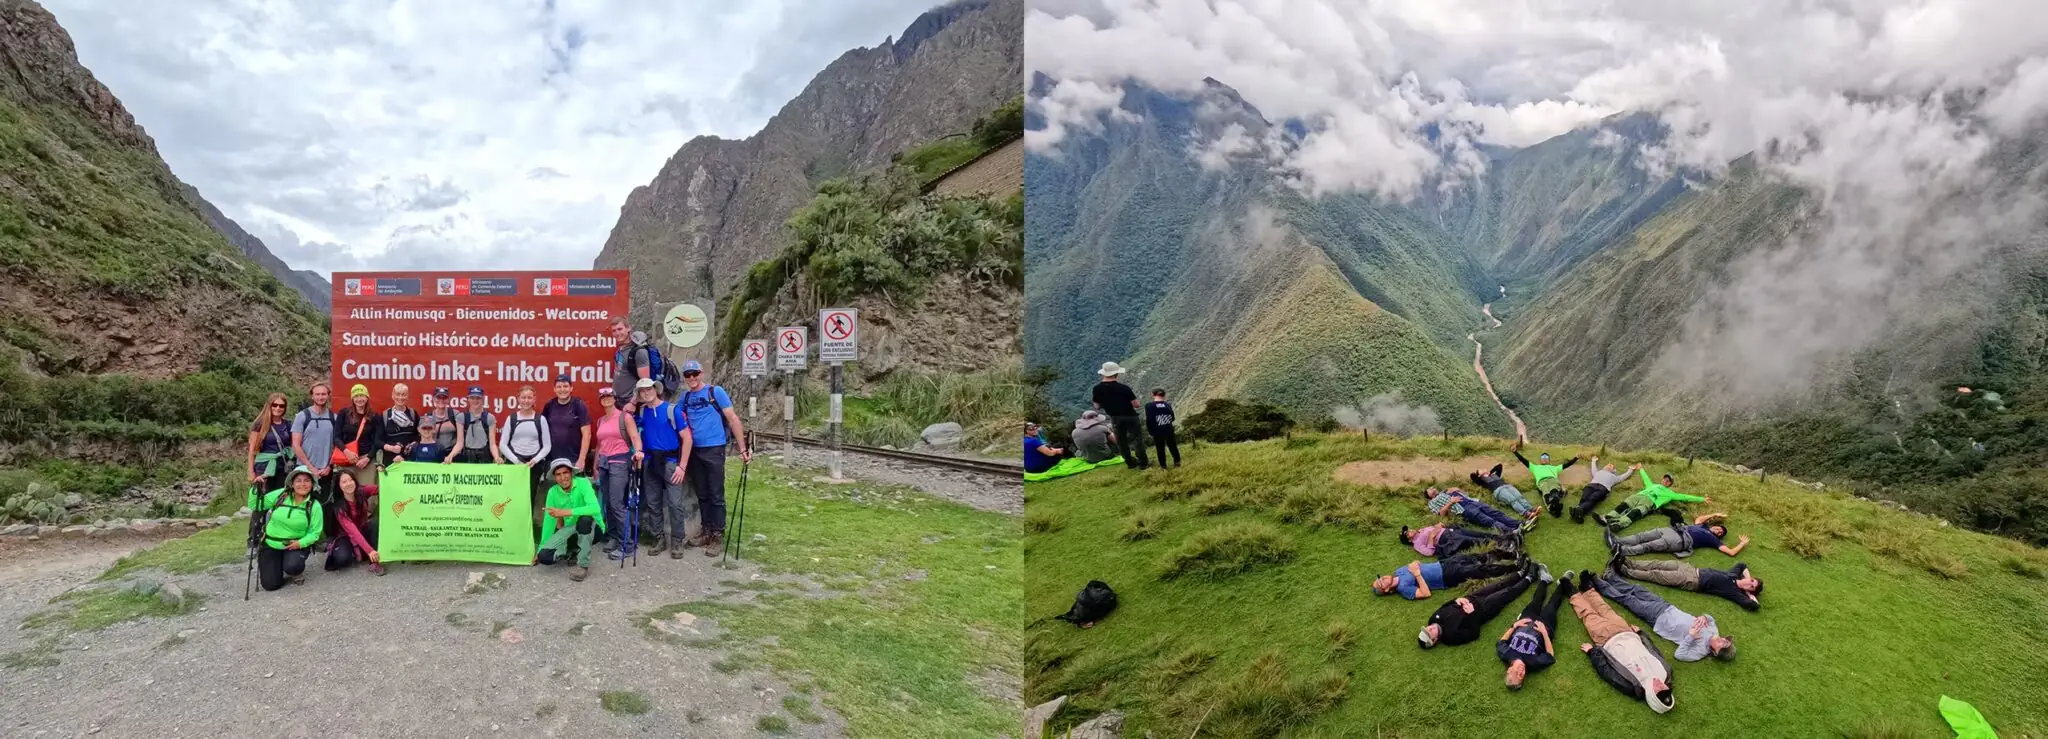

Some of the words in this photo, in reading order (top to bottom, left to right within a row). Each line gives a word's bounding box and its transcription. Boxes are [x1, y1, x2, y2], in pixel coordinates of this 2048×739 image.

[350, 308, 382, 320] Allin
[385, 308, 446, 322] Hamusqa
[456, 308, 535, 320] Bienvenidos
[545, 308, 608, 320] Welcome
[342, 332, 416, 347] Santuario
[419, 332, 488, 348] Histórico
[490, 333, 508, 348] de
[512, 333, 617, 351] Machupicchu
[342, 358, 426, 380] Camino
[430, 360, 480, 381] Inka
[498, 361, 548, 382] Inka
[554, 361, 614, 383] Trail
[422, 394, 467, 408] Ras
[493, 398, 503, 413] y
[507, 396, 521, 409] 0
[403, 473, 439, 484] TREKKING
[442, 474, 451, 484] TO
[453, 474, 503, 485] MACHUPICCHU
[420, 494, 444, 505] ALPACA
[455, 494, 483, 505] EXPEDITIONS
